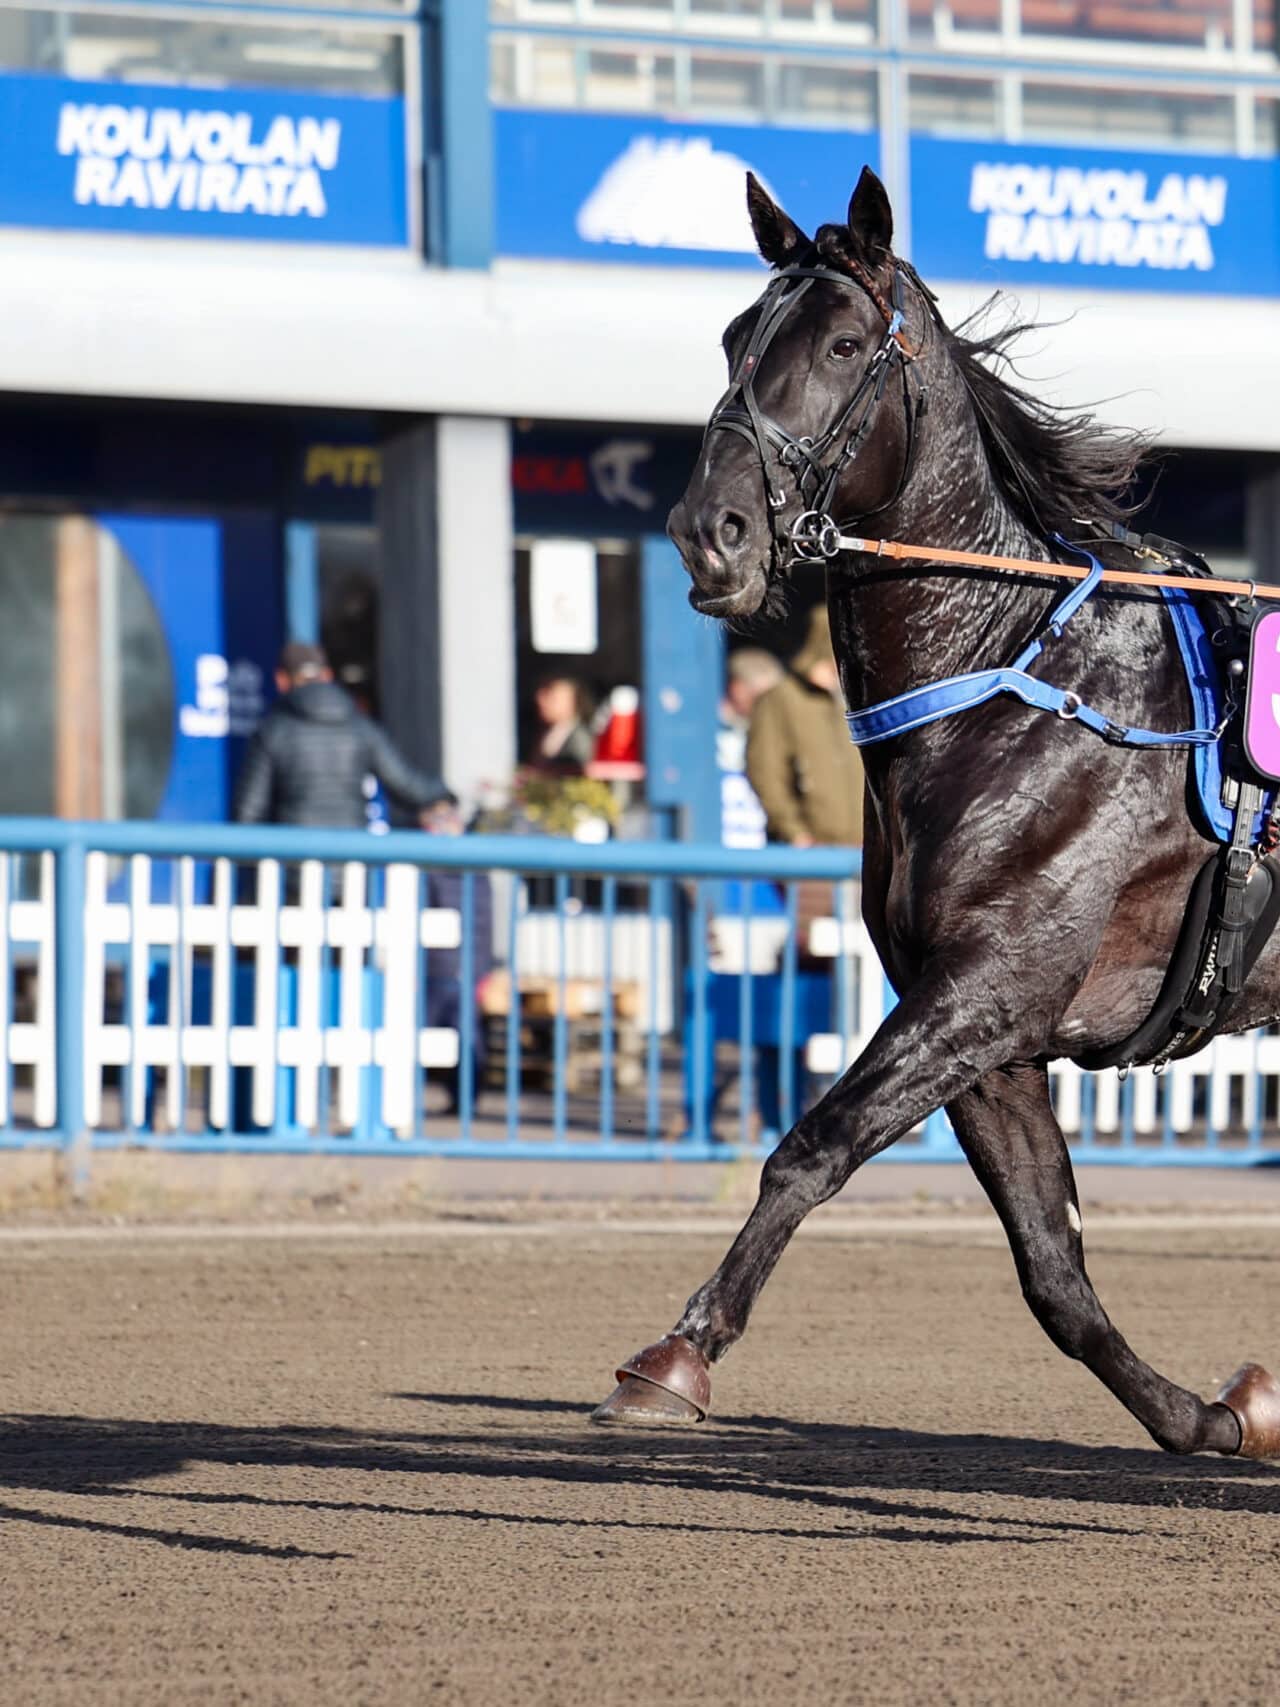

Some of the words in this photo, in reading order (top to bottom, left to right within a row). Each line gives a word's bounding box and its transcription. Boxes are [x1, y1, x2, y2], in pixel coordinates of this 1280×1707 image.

[58, 103, 340, 169] KOUVOLAN
[75, 157, 326, 217] RAVIRATA
[969, 162, 1227, 225] KOUVOLAN
[984, 214, 1214, 270] RAVIRATA
